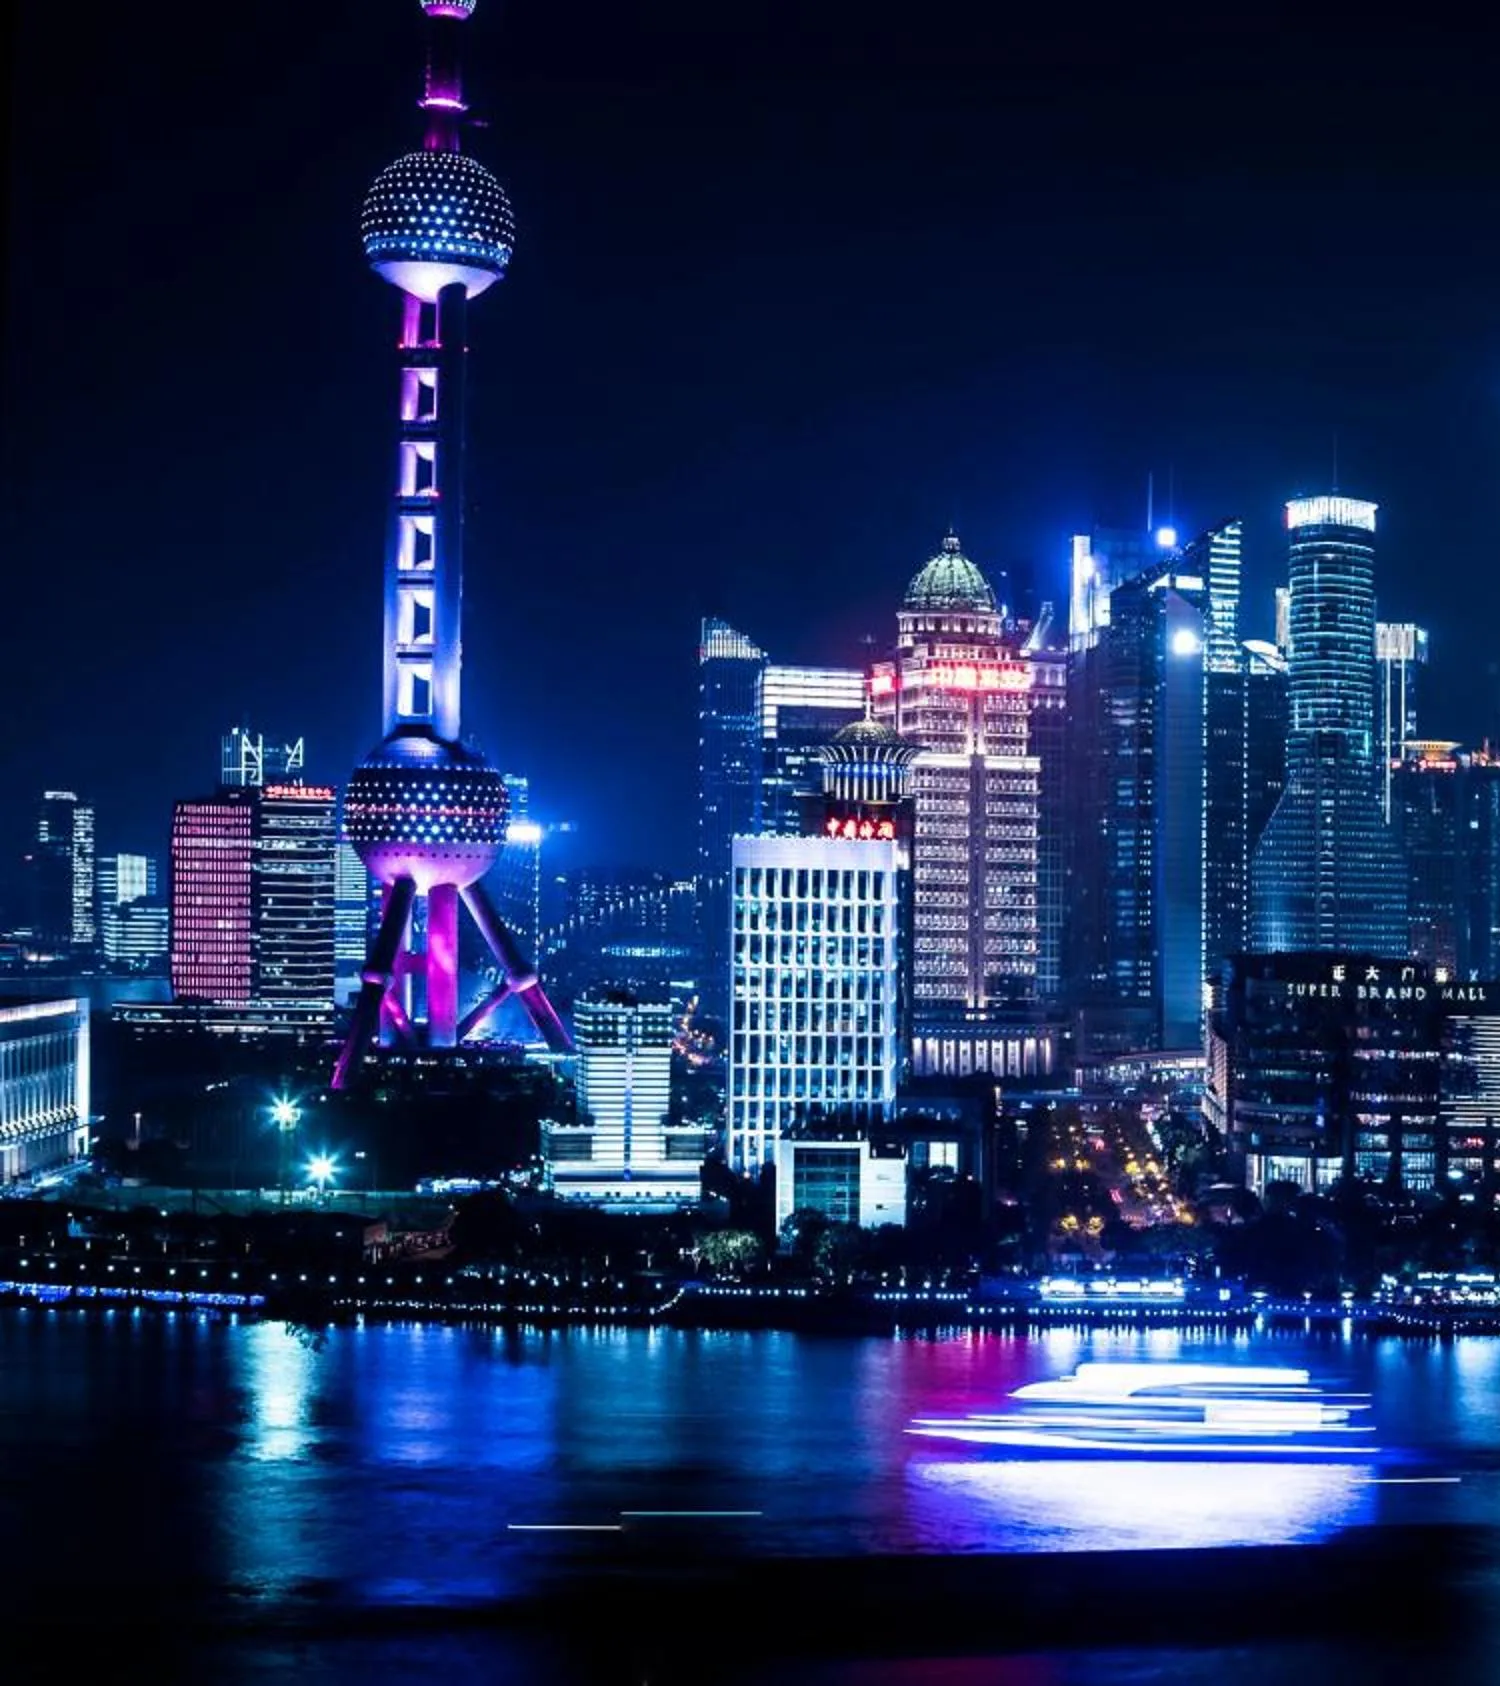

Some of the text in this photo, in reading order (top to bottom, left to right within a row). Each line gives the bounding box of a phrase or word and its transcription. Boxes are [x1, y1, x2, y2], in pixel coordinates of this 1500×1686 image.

[1287, 982, 1487, 1001] SUPER BRAND MALL
